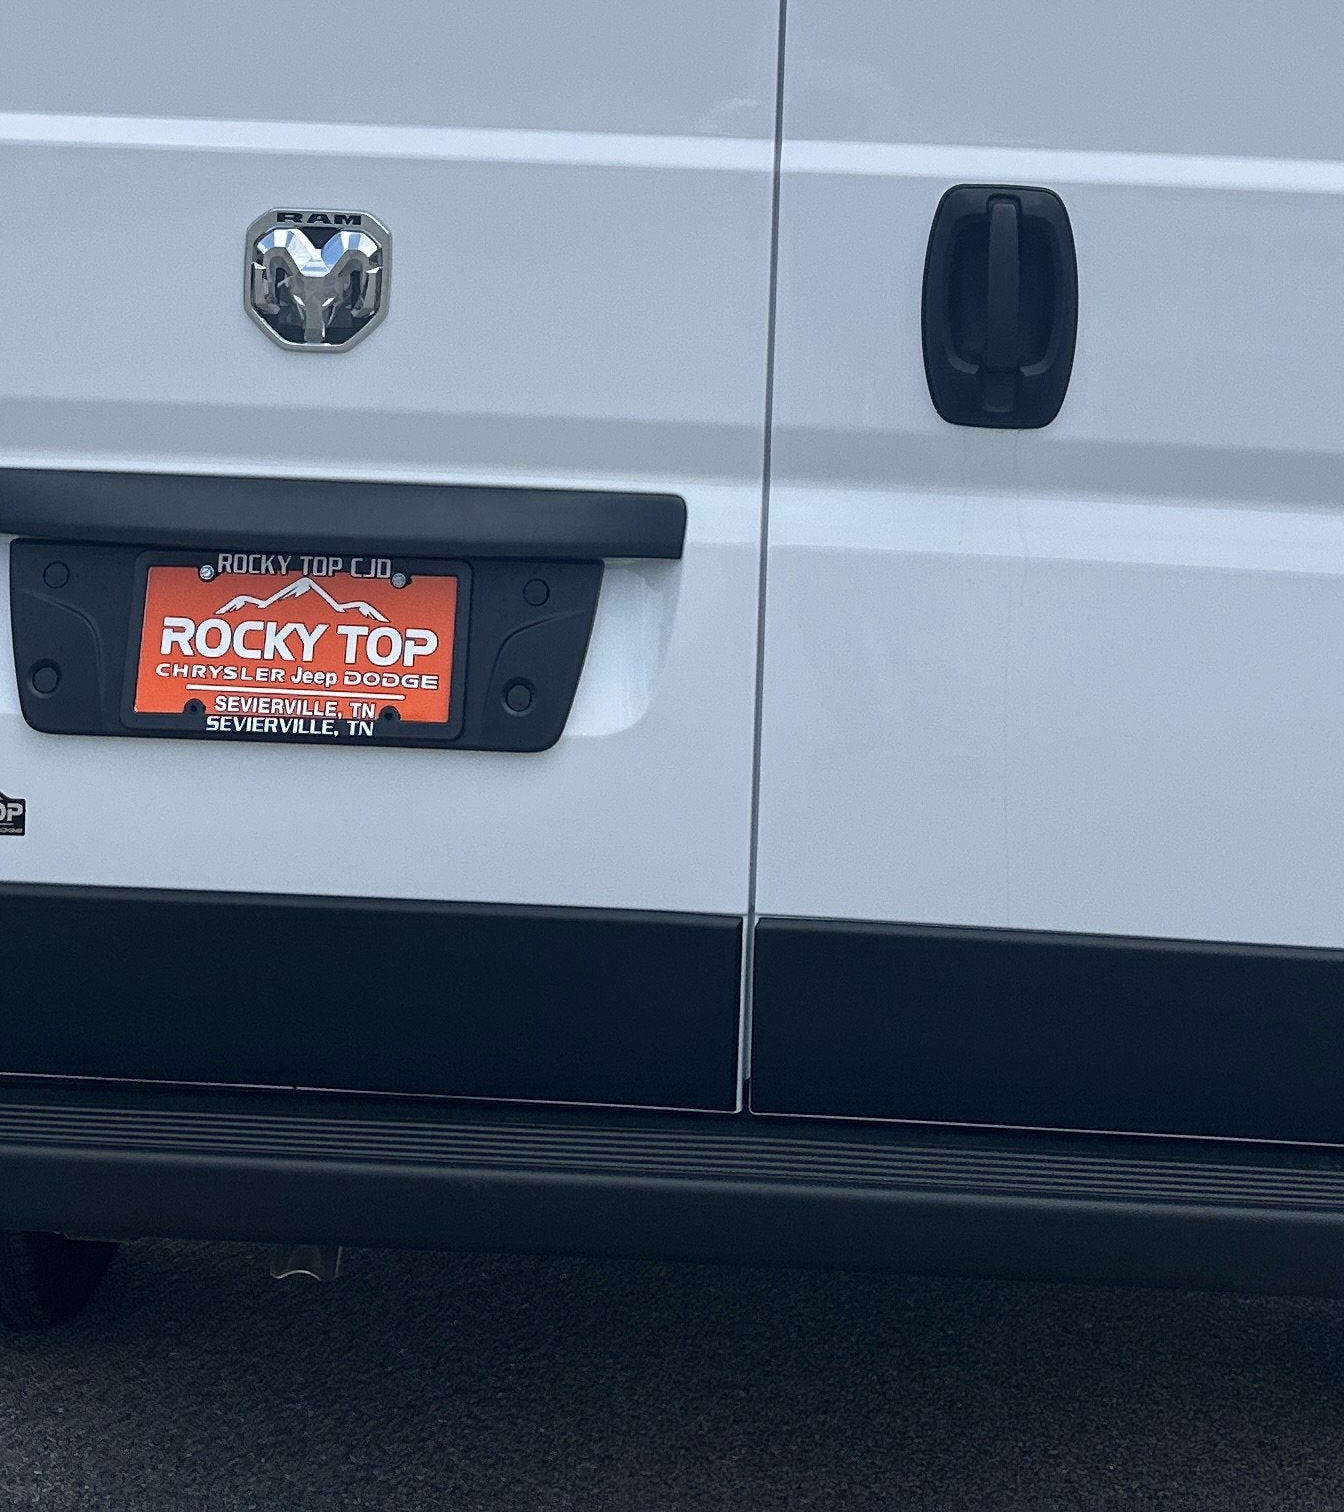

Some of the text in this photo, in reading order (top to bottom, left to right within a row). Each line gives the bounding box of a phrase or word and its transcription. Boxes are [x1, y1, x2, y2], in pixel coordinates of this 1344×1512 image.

[276, 212, 362, 226] RAM
[217, 553, 391, 579] ROCKY TOP CJD
[160, 616, 438, 667] ROCKY TOP
[155, 663, 439, 690] CHRYSLER Jeep DODGE
[214, 695, 376, 719] SEVIERVILLE, TN
[206, 715, 374, 737] SEVIERVILLE, TN
